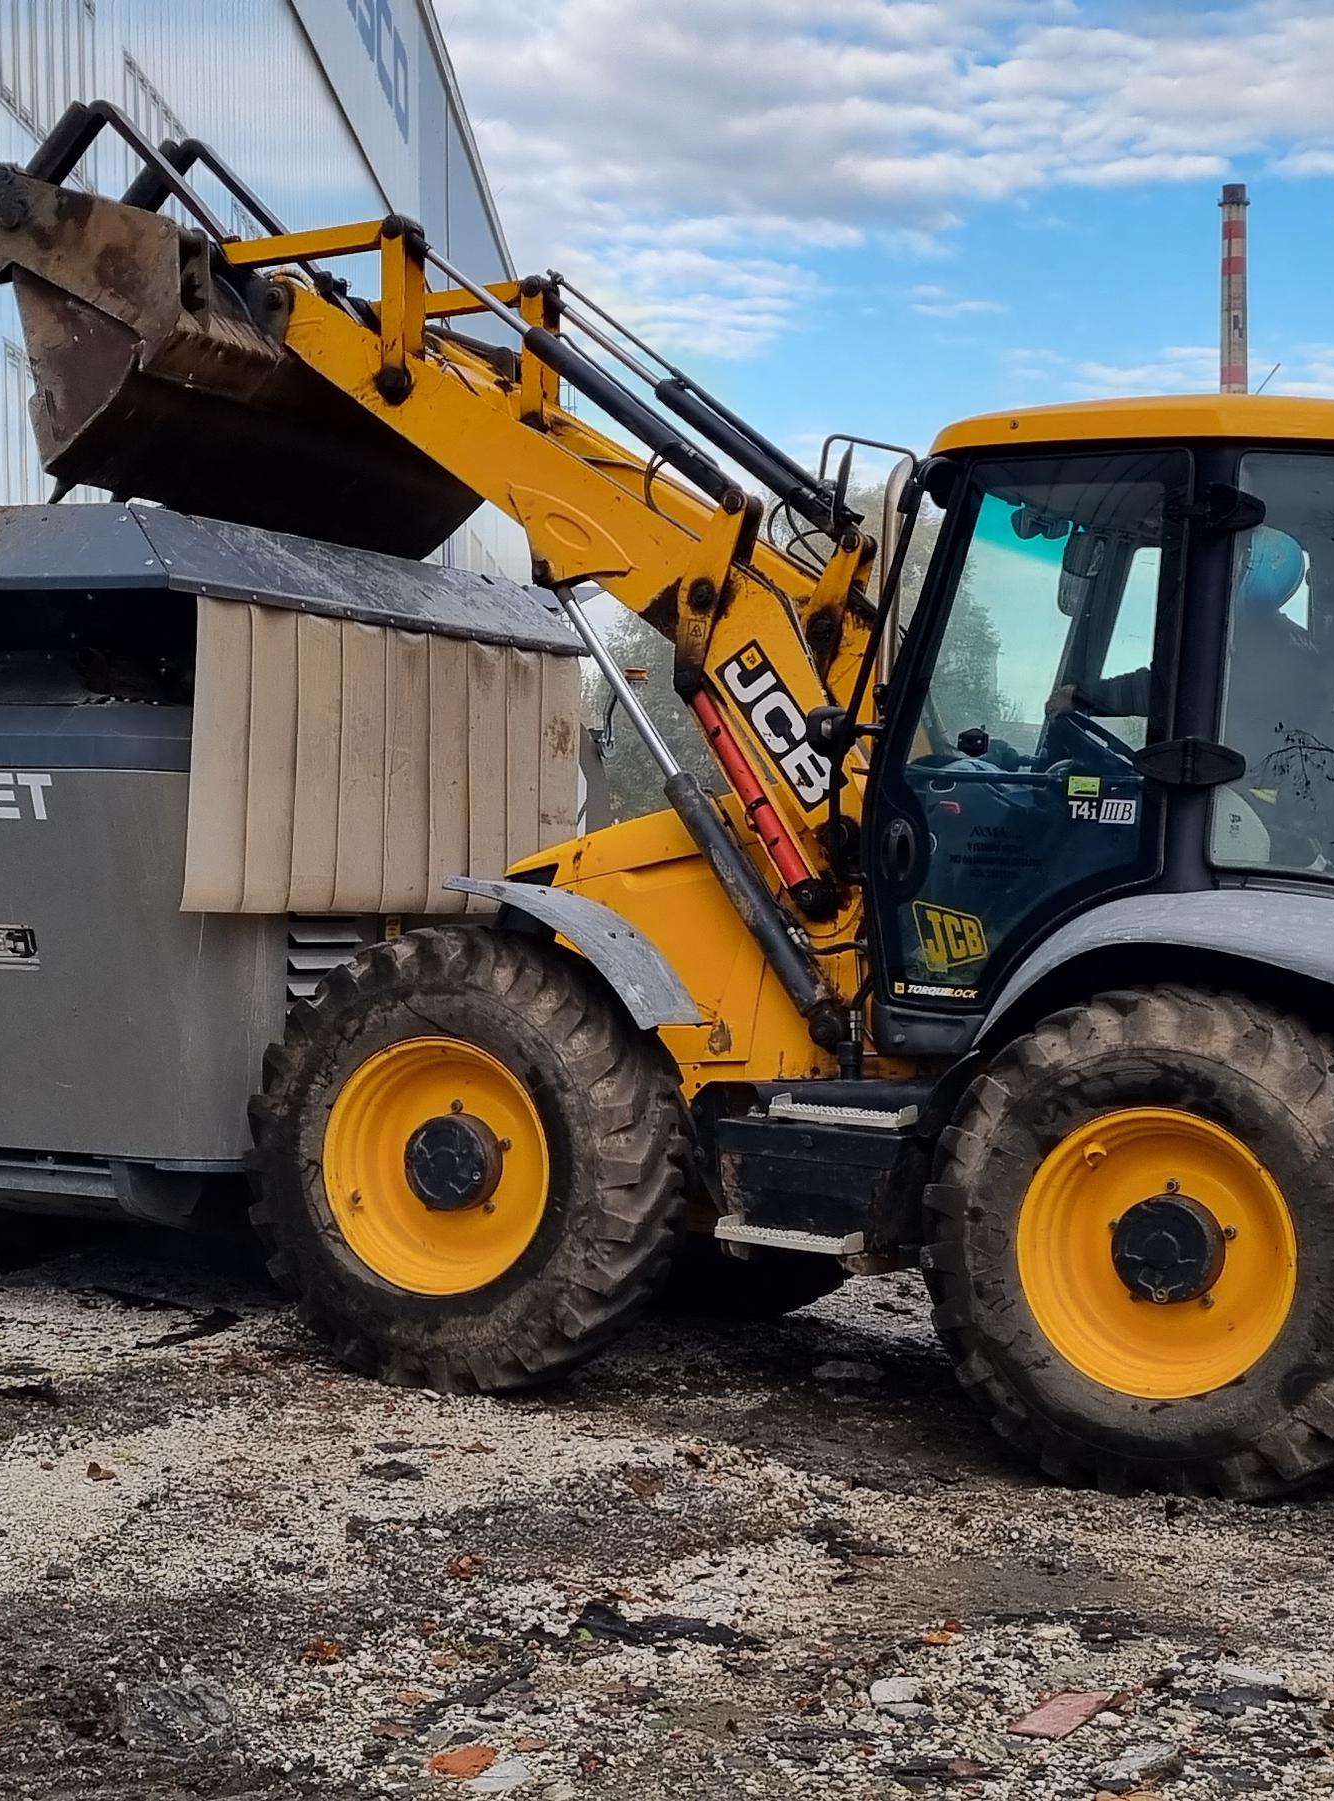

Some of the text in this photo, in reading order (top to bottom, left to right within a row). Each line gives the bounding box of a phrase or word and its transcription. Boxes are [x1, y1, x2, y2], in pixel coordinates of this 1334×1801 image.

[723, 660, 832, 803] JCB
[1068, 800, 1098, 820] T4i
[924, 909, 984, 966] JCB
